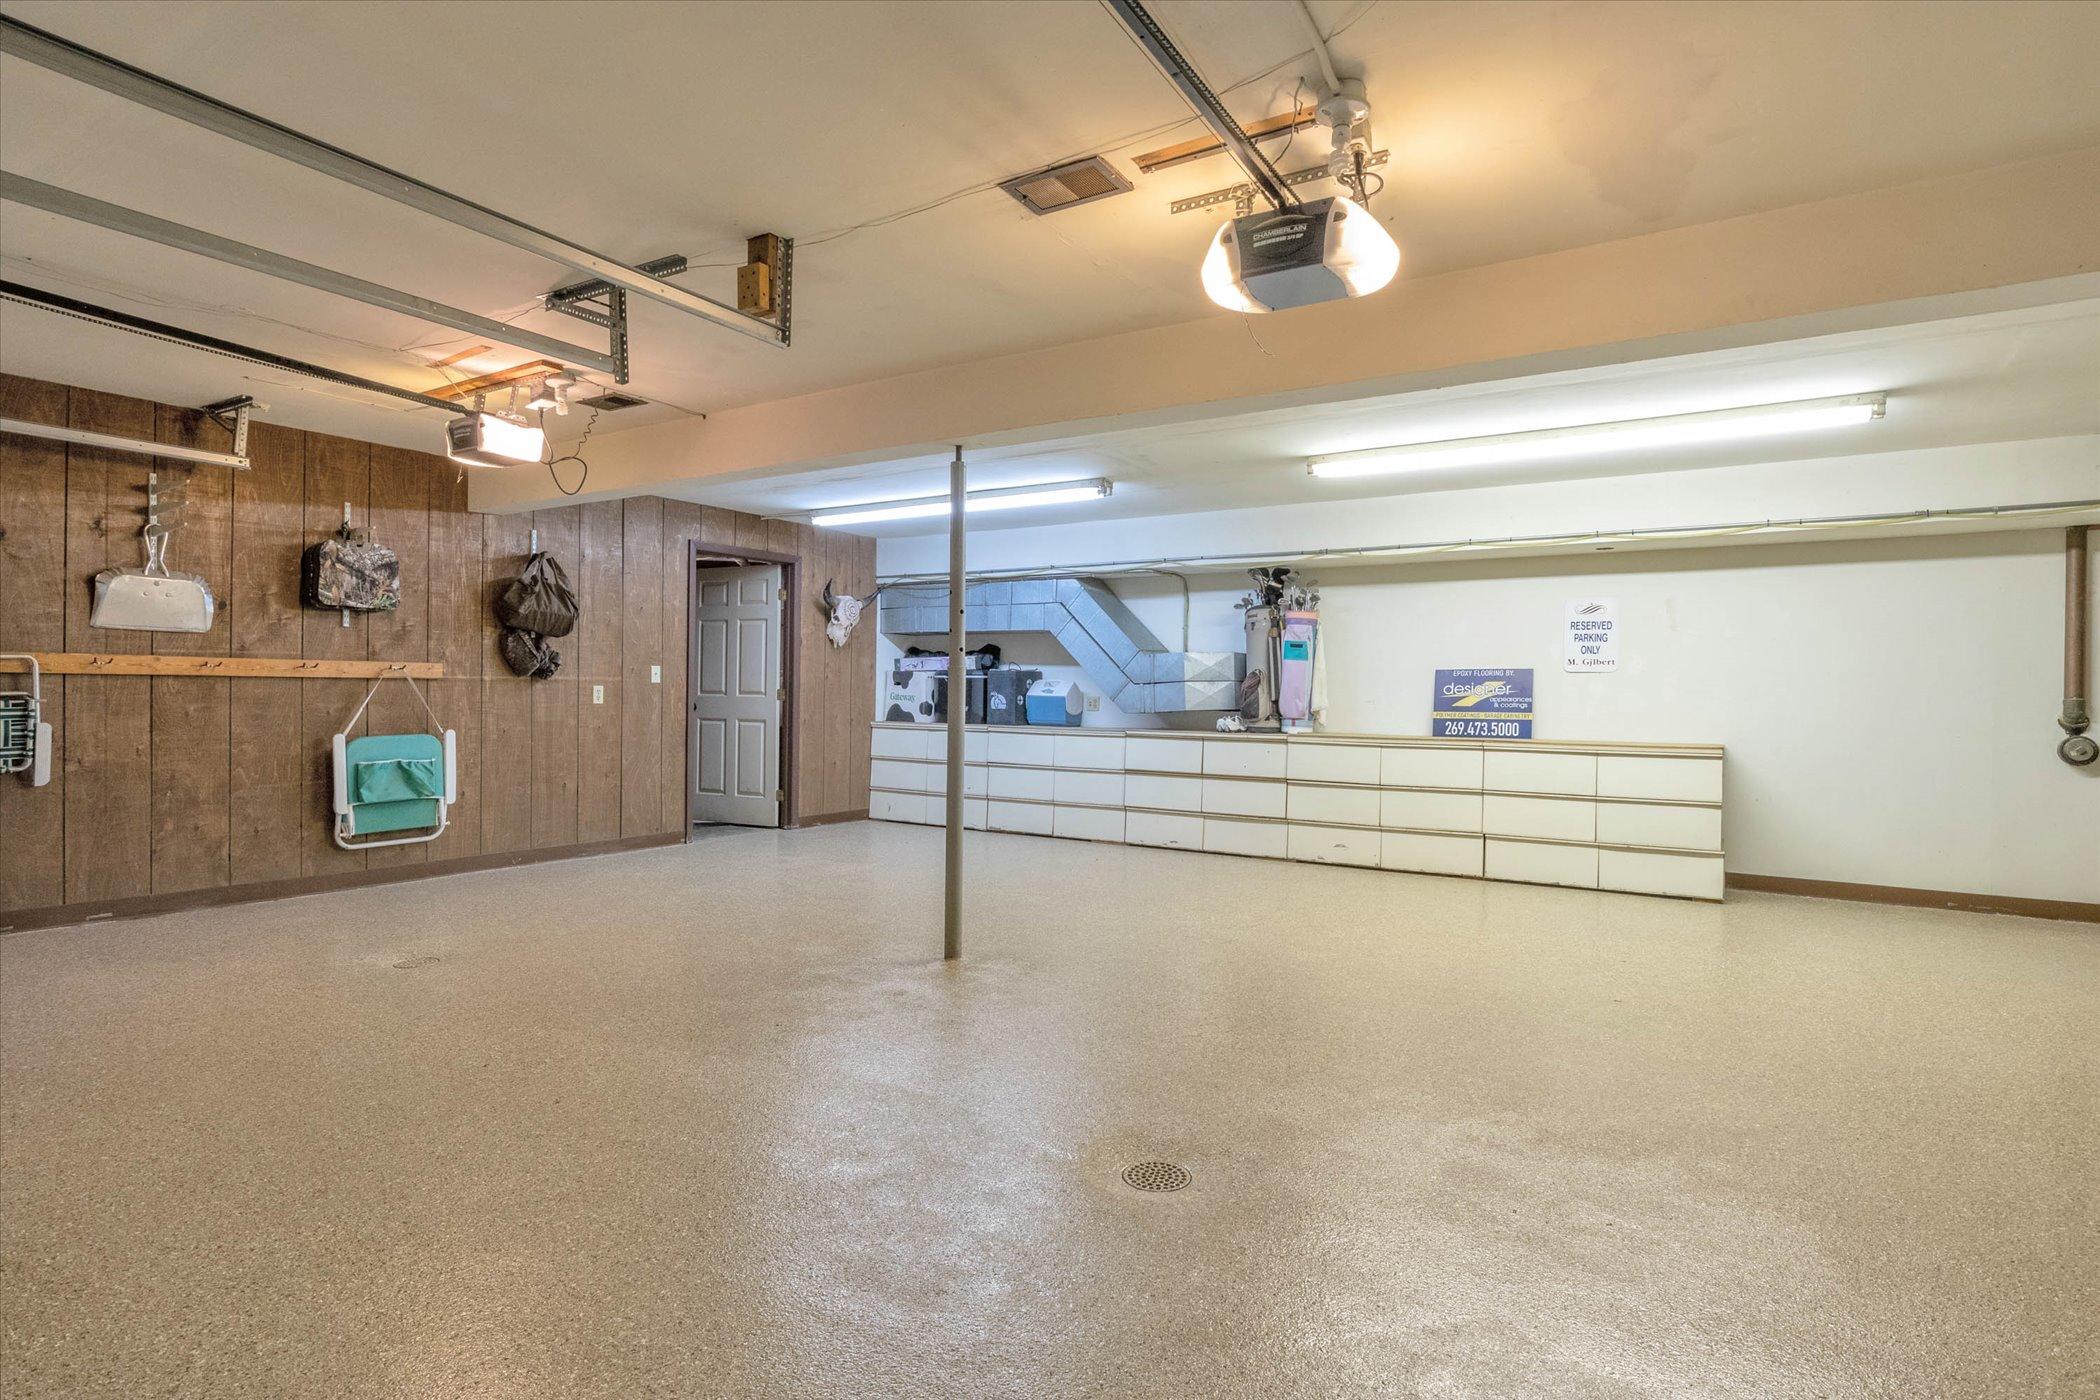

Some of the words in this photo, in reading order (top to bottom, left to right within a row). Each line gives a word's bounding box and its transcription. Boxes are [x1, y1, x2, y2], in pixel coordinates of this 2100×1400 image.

[1570, 620, 1613, 631] RESERVED
[1574, 633, 1608, 643] PARKING
[1580, 645, 1601, 655] ONLY
[1568, 658, 1579, 666] M.
[1453, 669, 1473, 677] EPOXY
[1474, 669, 1504, 677] FLOORING
[1443, 683, 1512, 698] designer
[889, 691, 916, 703] Gateway
[1444, 721, 1519, 737] 269.473.5000
